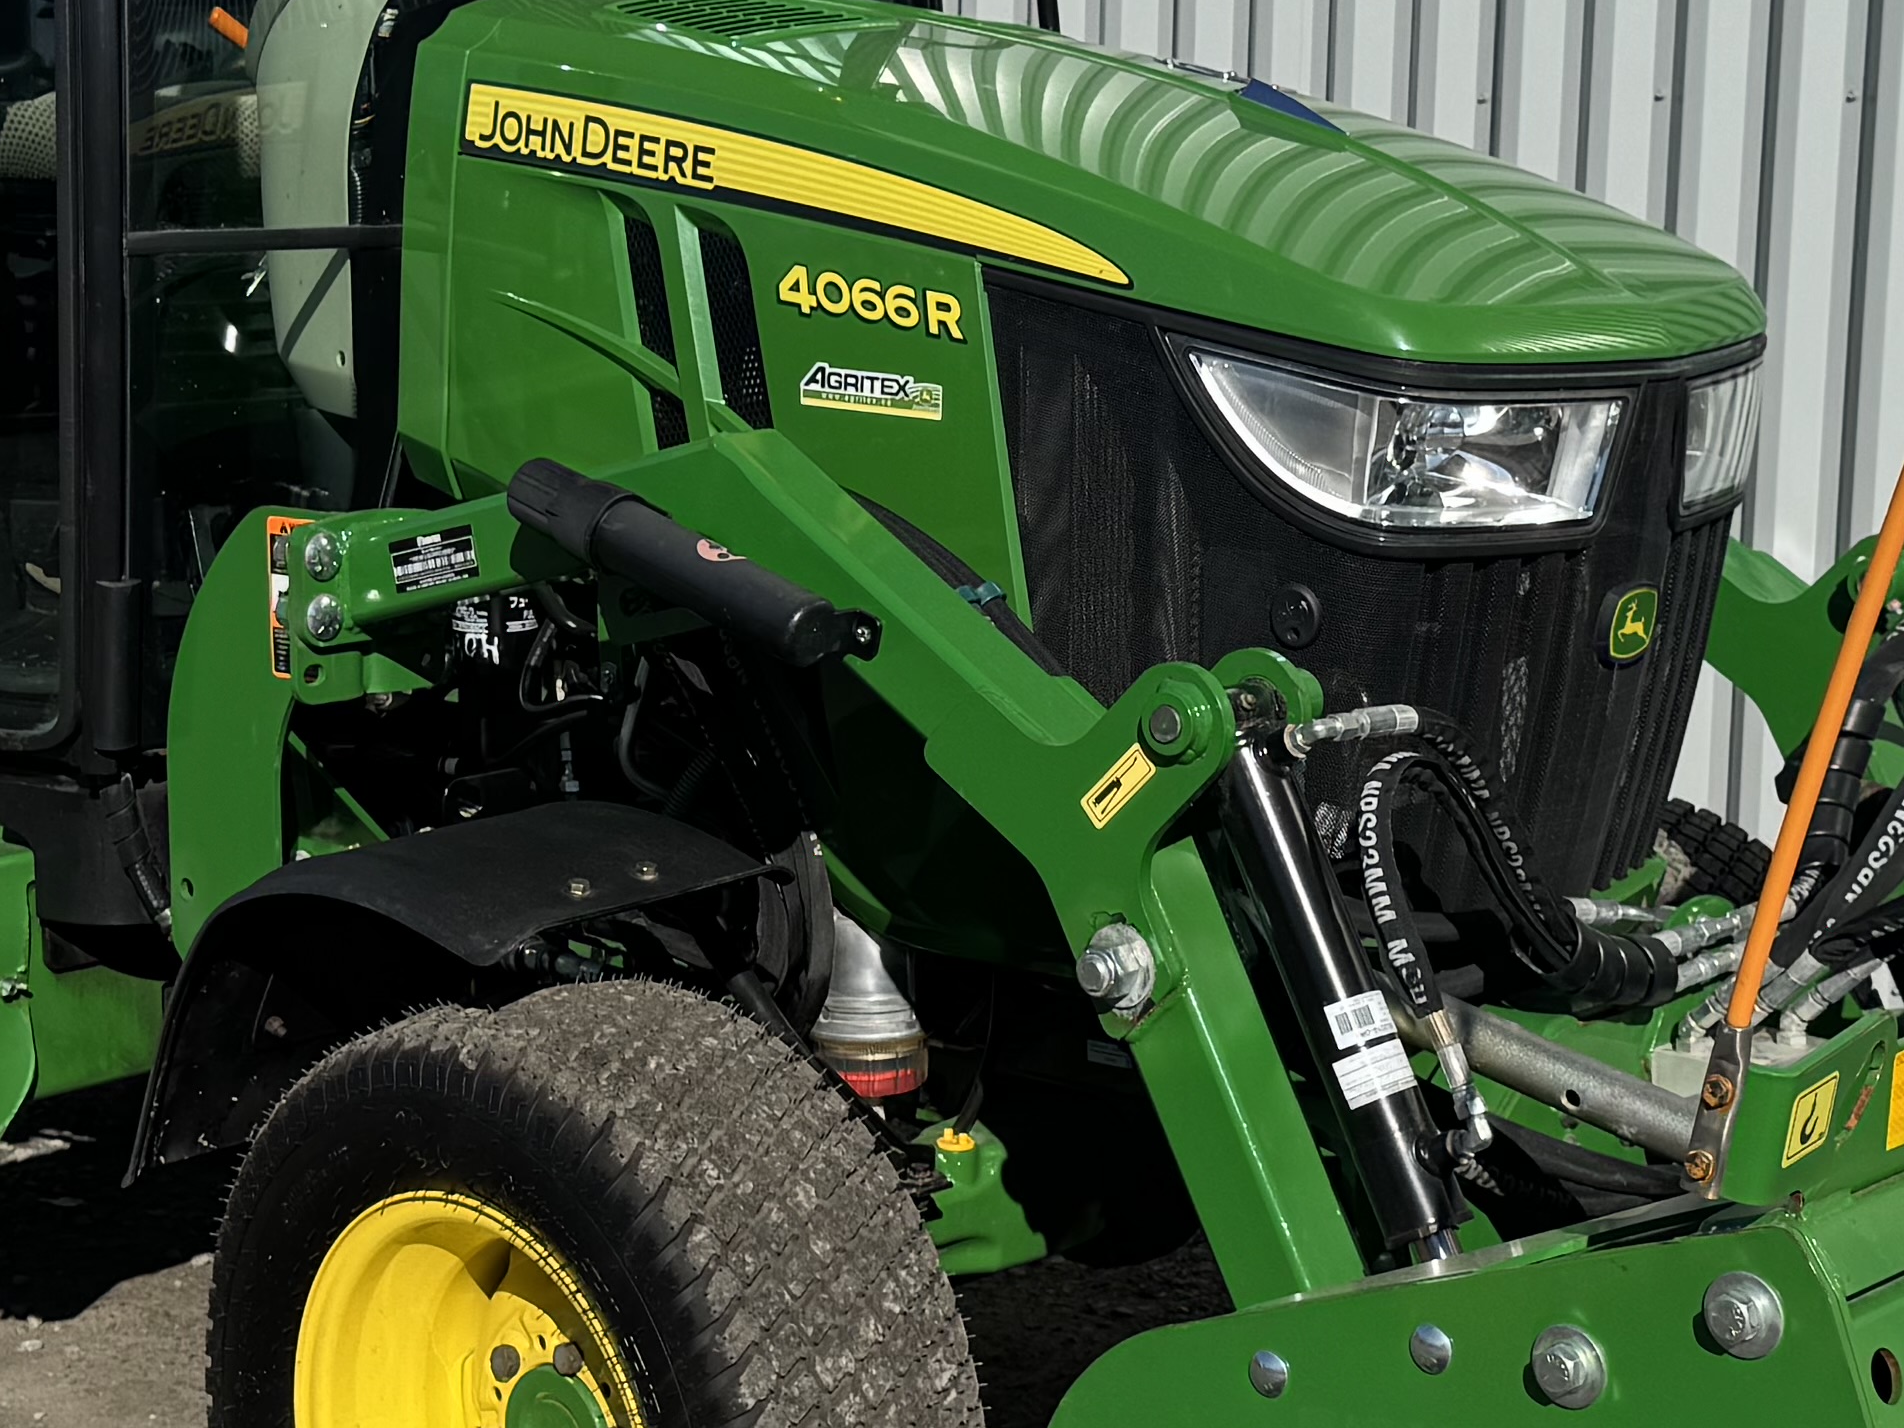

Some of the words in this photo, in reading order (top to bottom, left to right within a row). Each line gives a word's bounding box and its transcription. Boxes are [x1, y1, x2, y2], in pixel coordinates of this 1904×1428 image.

[478, 100, 574, 161] JOHN
[580, 115, 717, 185] DEERE
[778, 264, 965, 342] 4066R
[803, 365, 911, 399] AGRITEX
